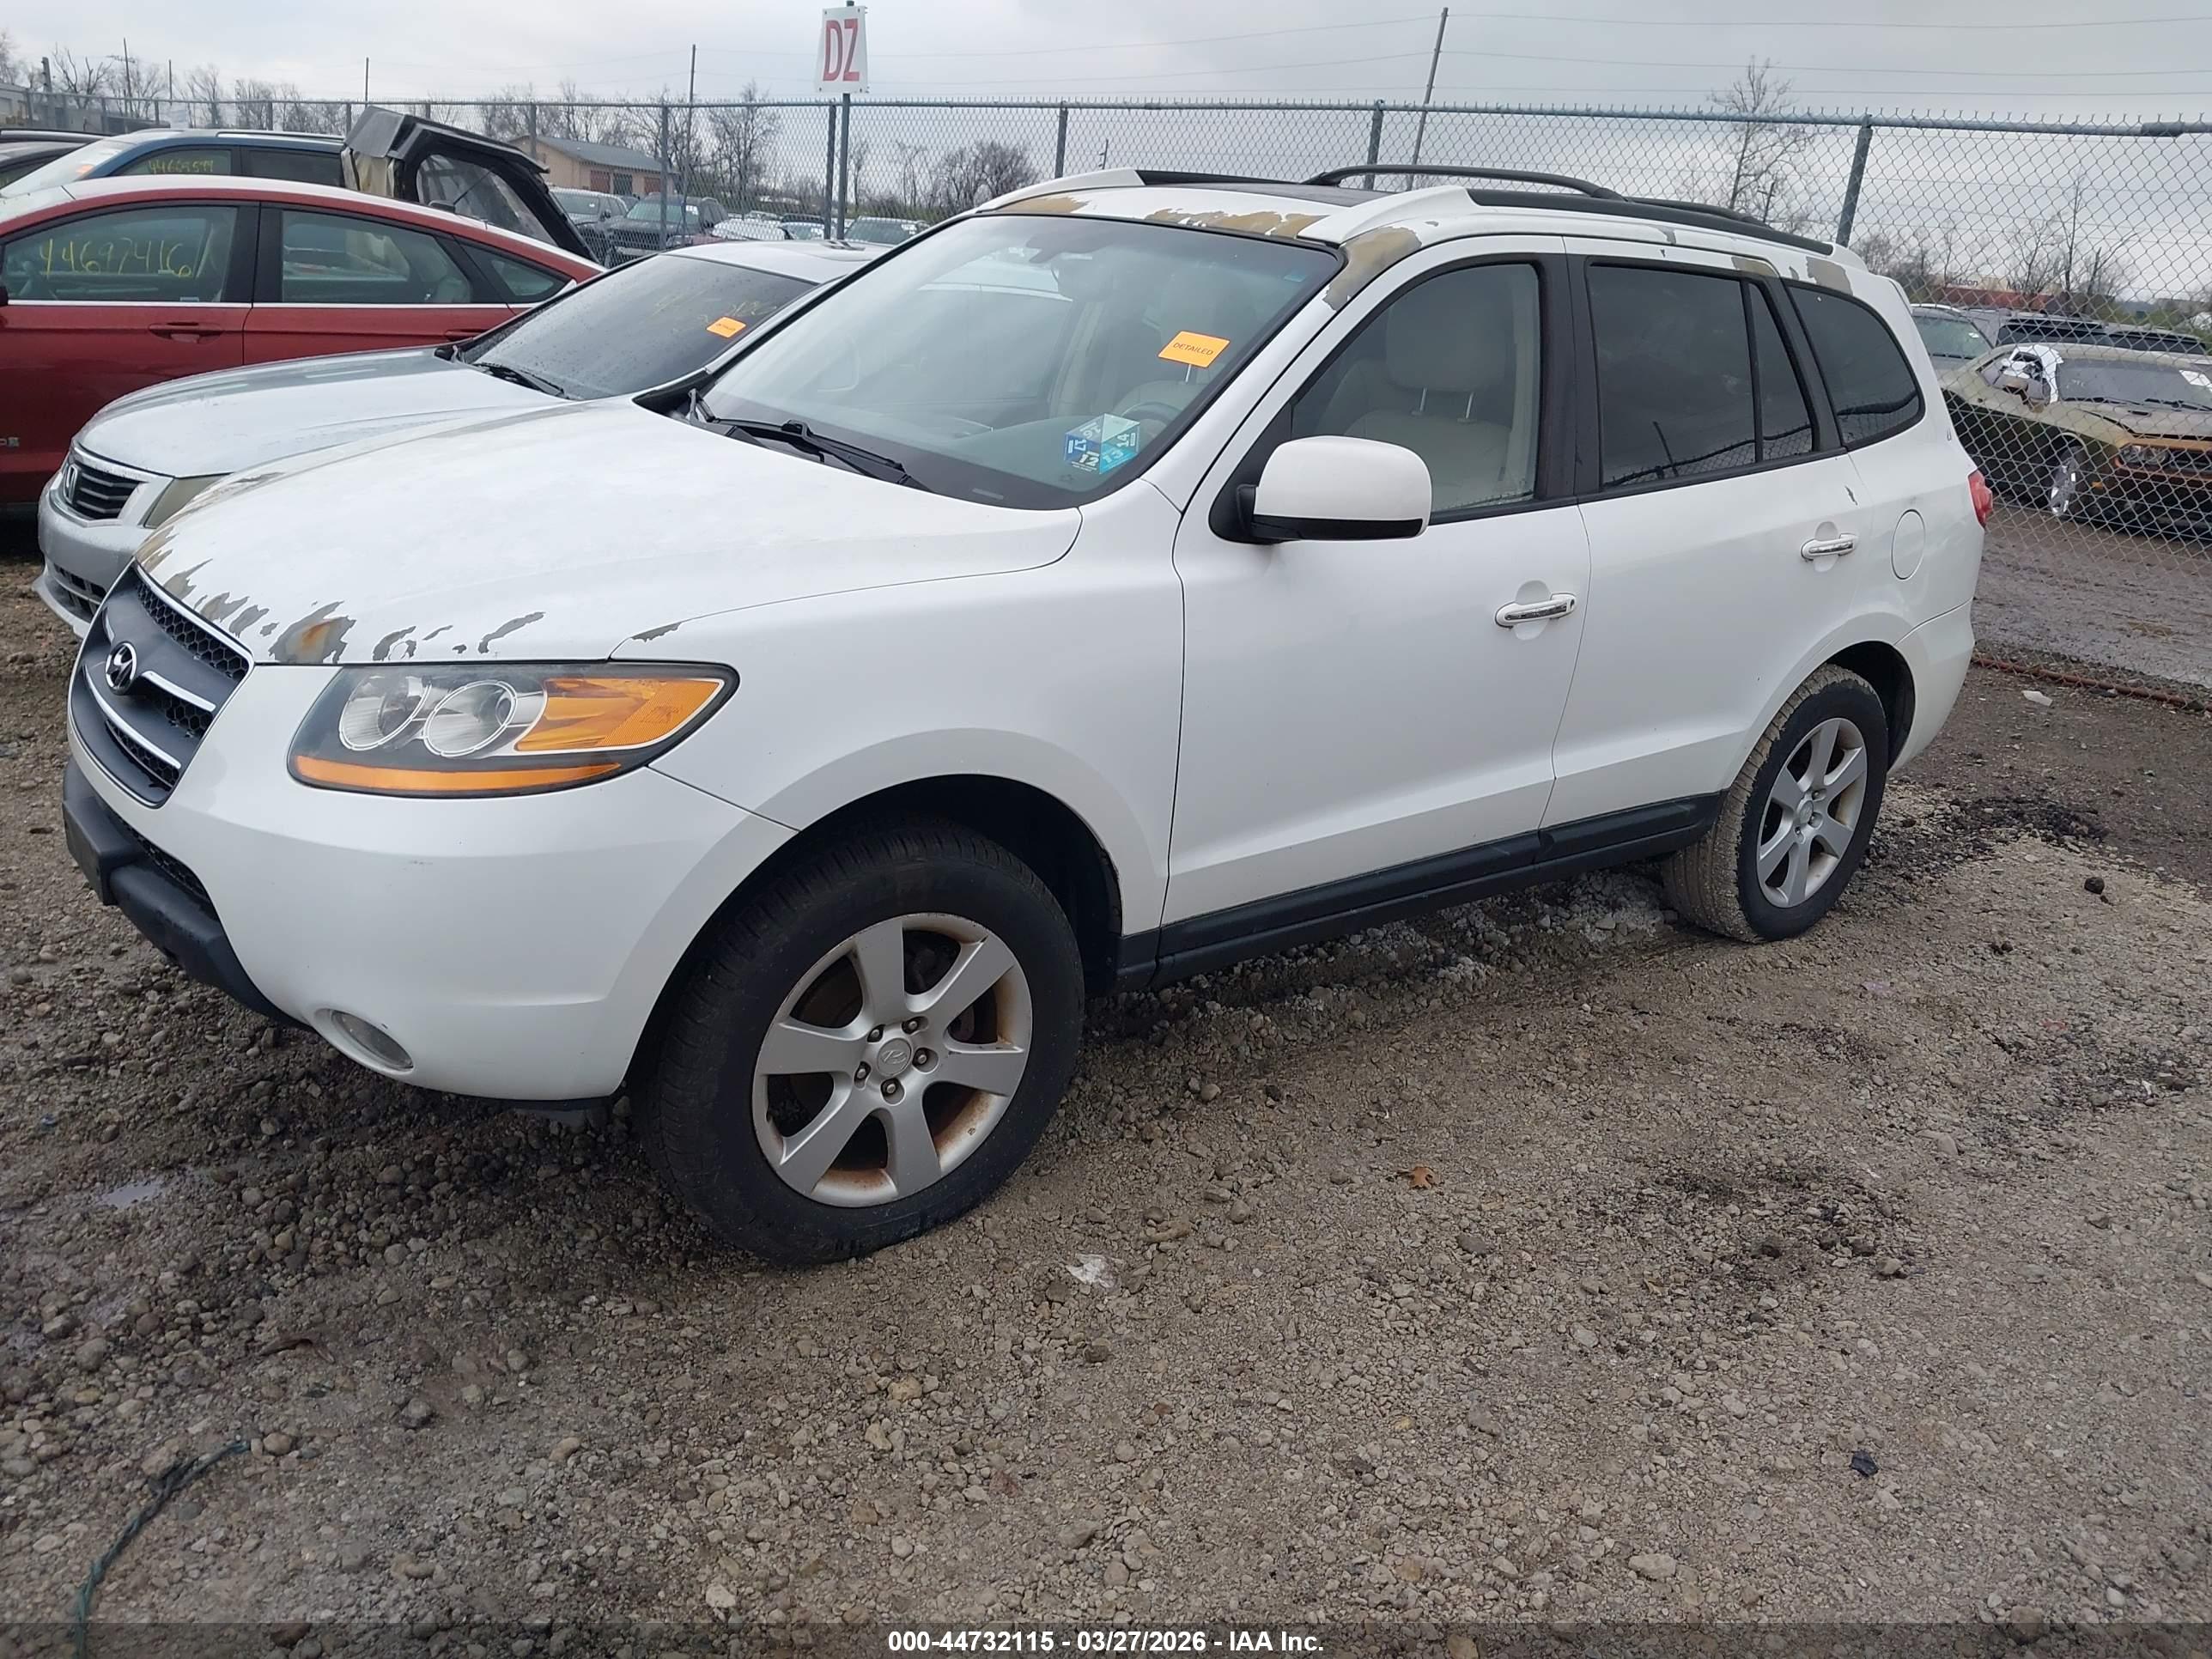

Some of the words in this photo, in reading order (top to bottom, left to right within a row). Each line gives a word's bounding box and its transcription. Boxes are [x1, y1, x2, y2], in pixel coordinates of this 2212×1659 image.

[822, 18, 860, 82] DZ
[40, 238, 192, 279] 44697416
[1173, 342, 1213, 356] DETAILED
[1073, 439, 1087, 452] 17
[1116, 433, 1130, 447] 14
[1079, 453, 1100, 467] 12
[1103, 447, 1124, 464] 13
